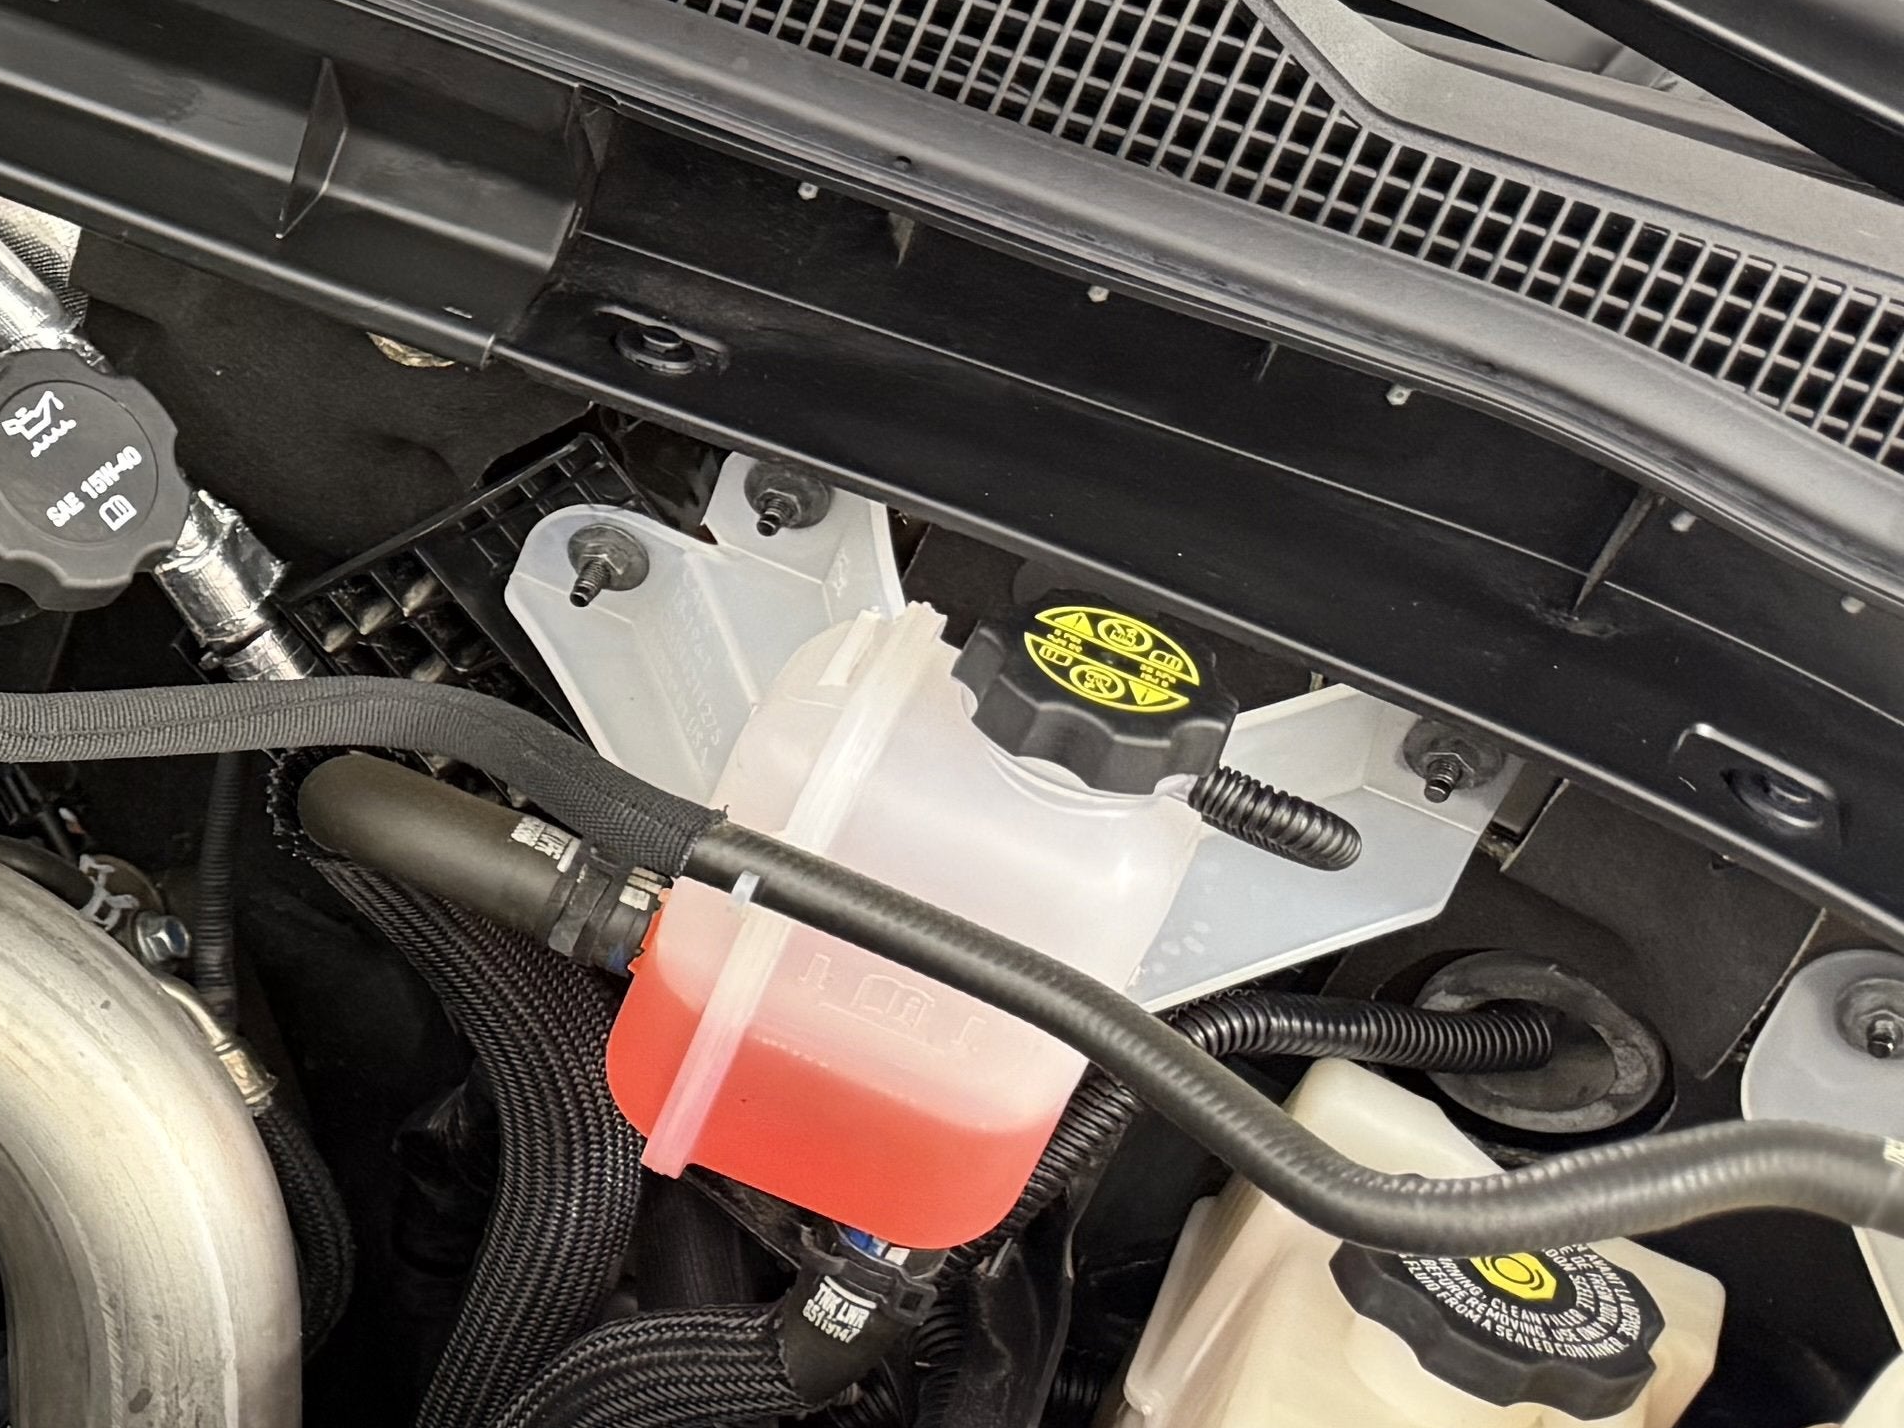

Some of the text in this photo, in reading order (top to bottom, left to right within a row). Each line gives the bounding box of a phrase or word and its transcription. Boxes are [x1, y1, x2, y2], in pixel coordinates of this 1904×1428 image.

[46, 445, 142, 527] SAE 15W-40
[1402, 1260, 1441, 1292] FLUID
[1436, 1291, 1481, 1323] FROM
[1480, 1318, 1492, 1332] A
[1495, 1324, 1554, 1354] SEALED
[1419, 1258, 1469, 1300] BEFORE
[1490, 1297, 1541, 1325] CLEAN
